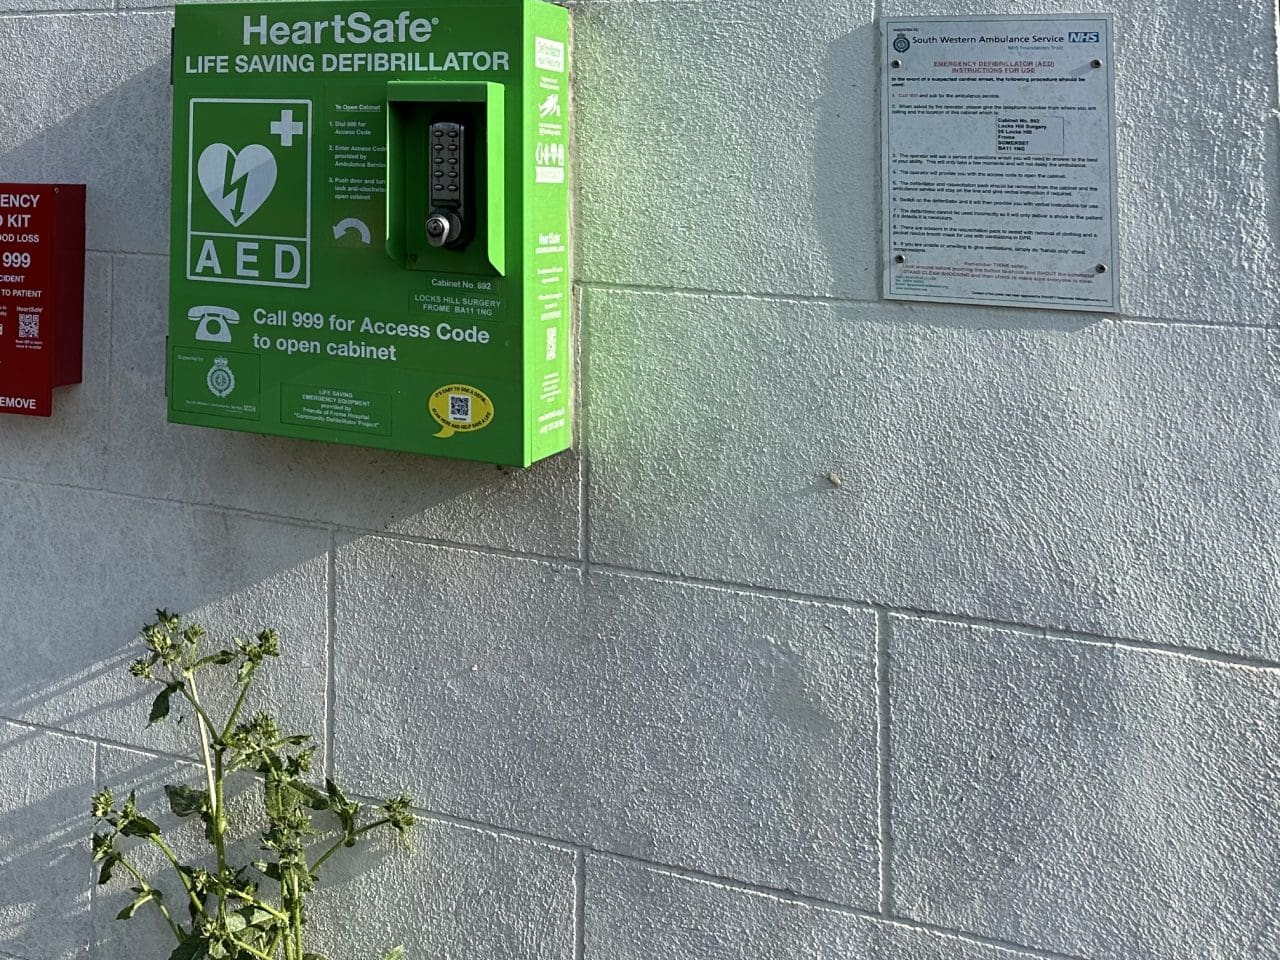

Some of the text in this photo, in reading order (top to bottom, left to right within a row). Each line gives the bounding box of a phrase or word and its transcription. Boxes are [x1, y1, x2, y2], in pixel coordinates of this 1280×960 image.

[243, 11, 439, 46] HeartSafe
[912, 32, 1099, 44] South Western Ambulance Service NHS
[185, 50, 509, 74] LIFE SAVING DEFIBRILLATOR
[7, 214, 31, 228] KIT
[17, 234, 40, 243] LOSS
[3, 252, 31, 268] 999
[432, 279, 460, 287] Cabinet
[463, 281, 475, 289] No.
[1, 288, 11, 297] TO
[12, 289, 42, 298] PATIENT
[423, 304, 450, 312] FROME
[455, 306, 474, 314] BA11
[462, 298, 501, 308] SURGERY
[253, 308, 489, 344] Call 999 for Access Code
[253, 333, 396, 361] to open cabinet
